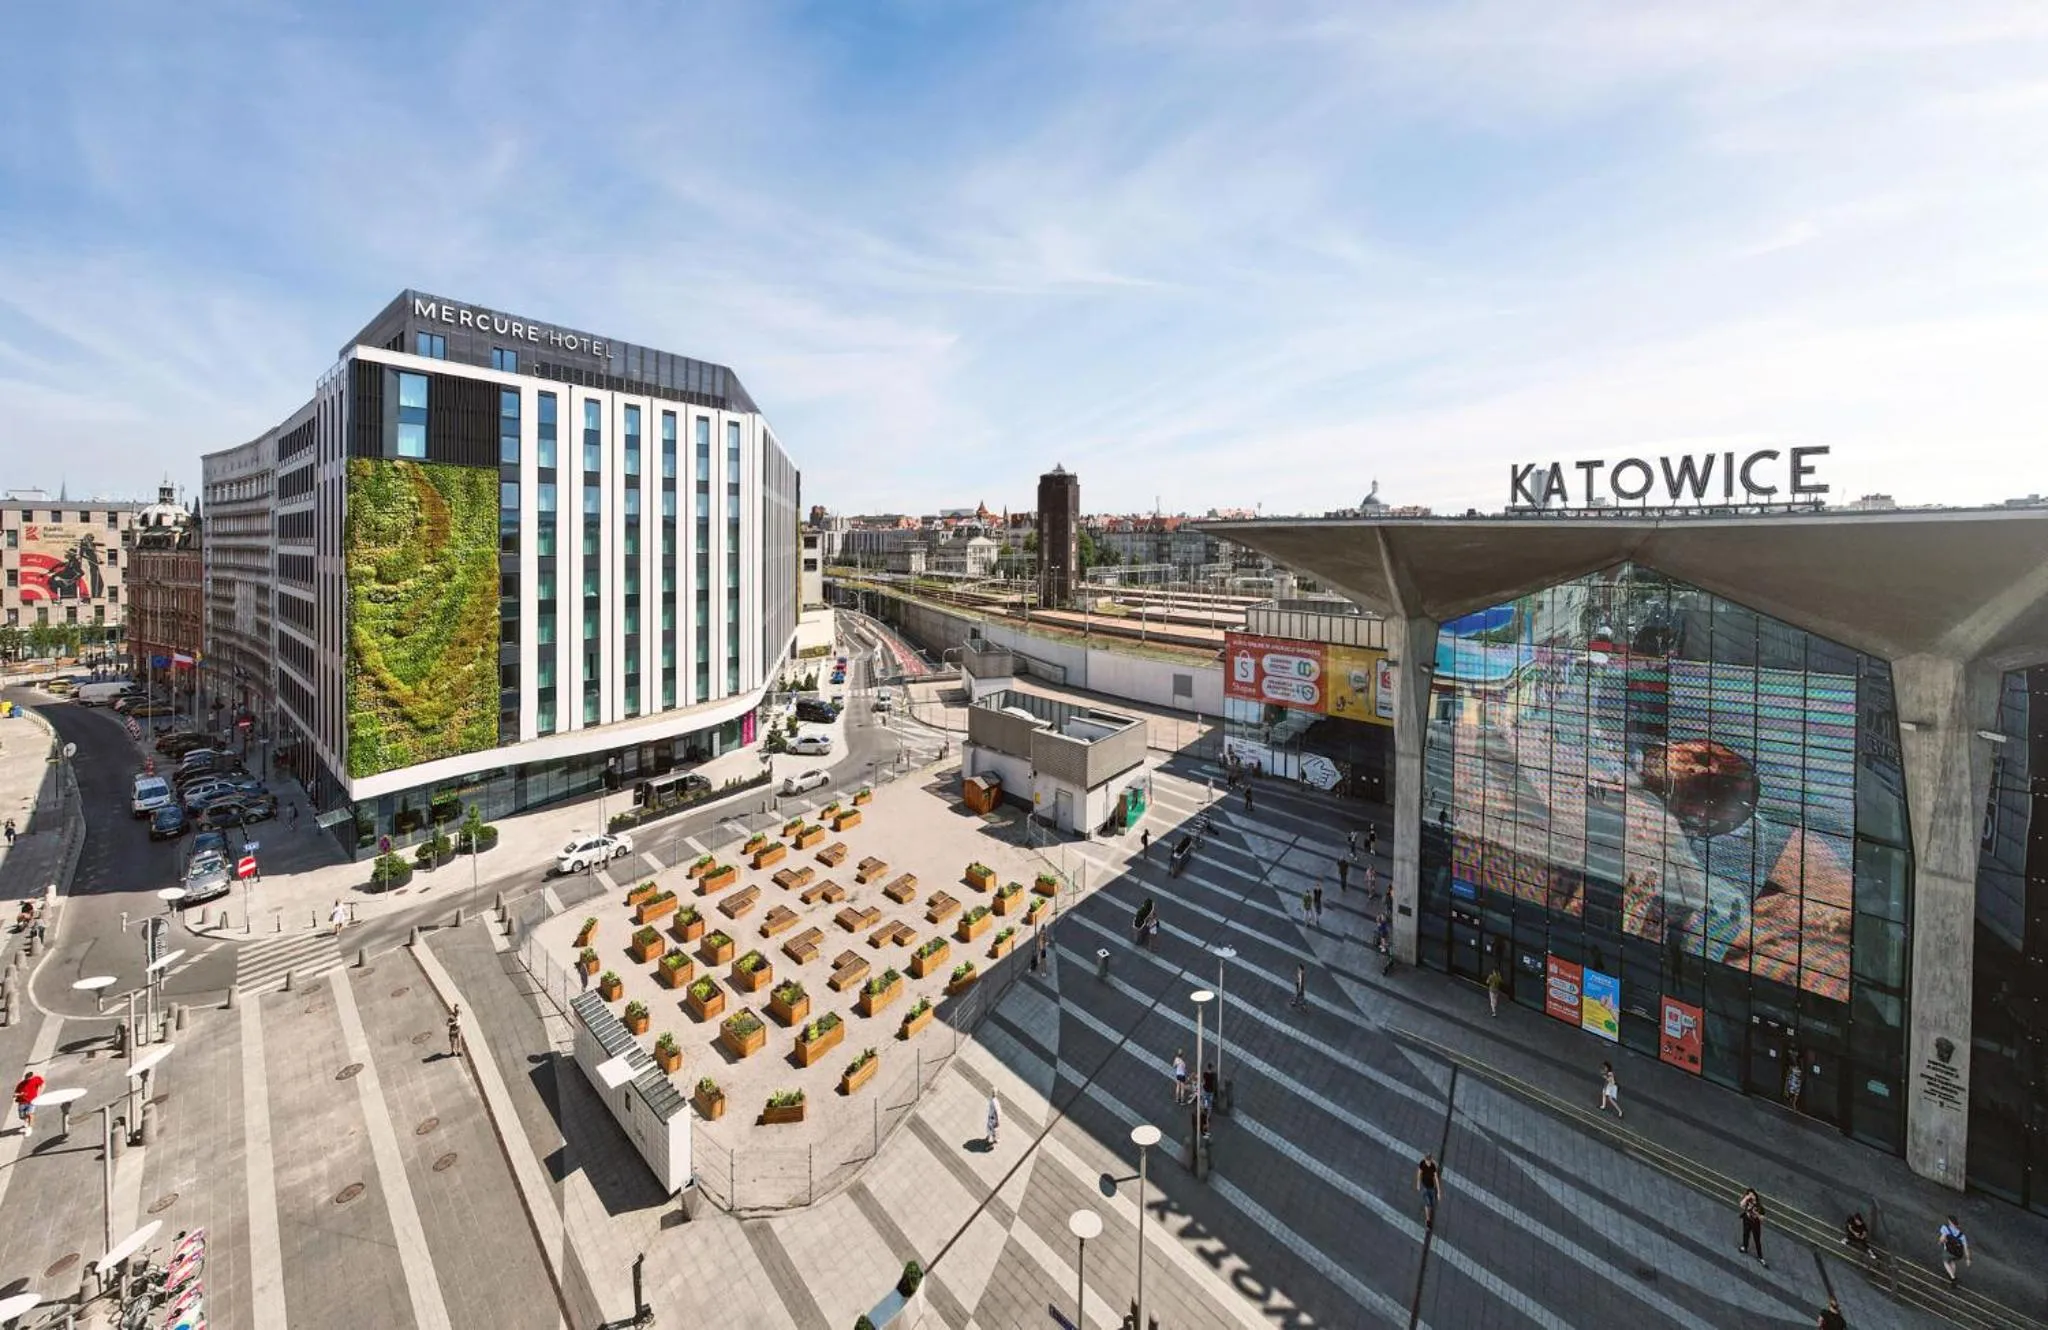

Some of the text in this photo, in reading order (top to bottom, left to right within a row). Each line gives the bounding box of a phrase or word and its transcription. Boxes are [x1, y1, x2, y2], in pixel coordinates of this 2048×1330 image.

[415, 299, 614, 358] MERCURE HOTEL
[1510, 446, 1830, 502] KATOWICE
